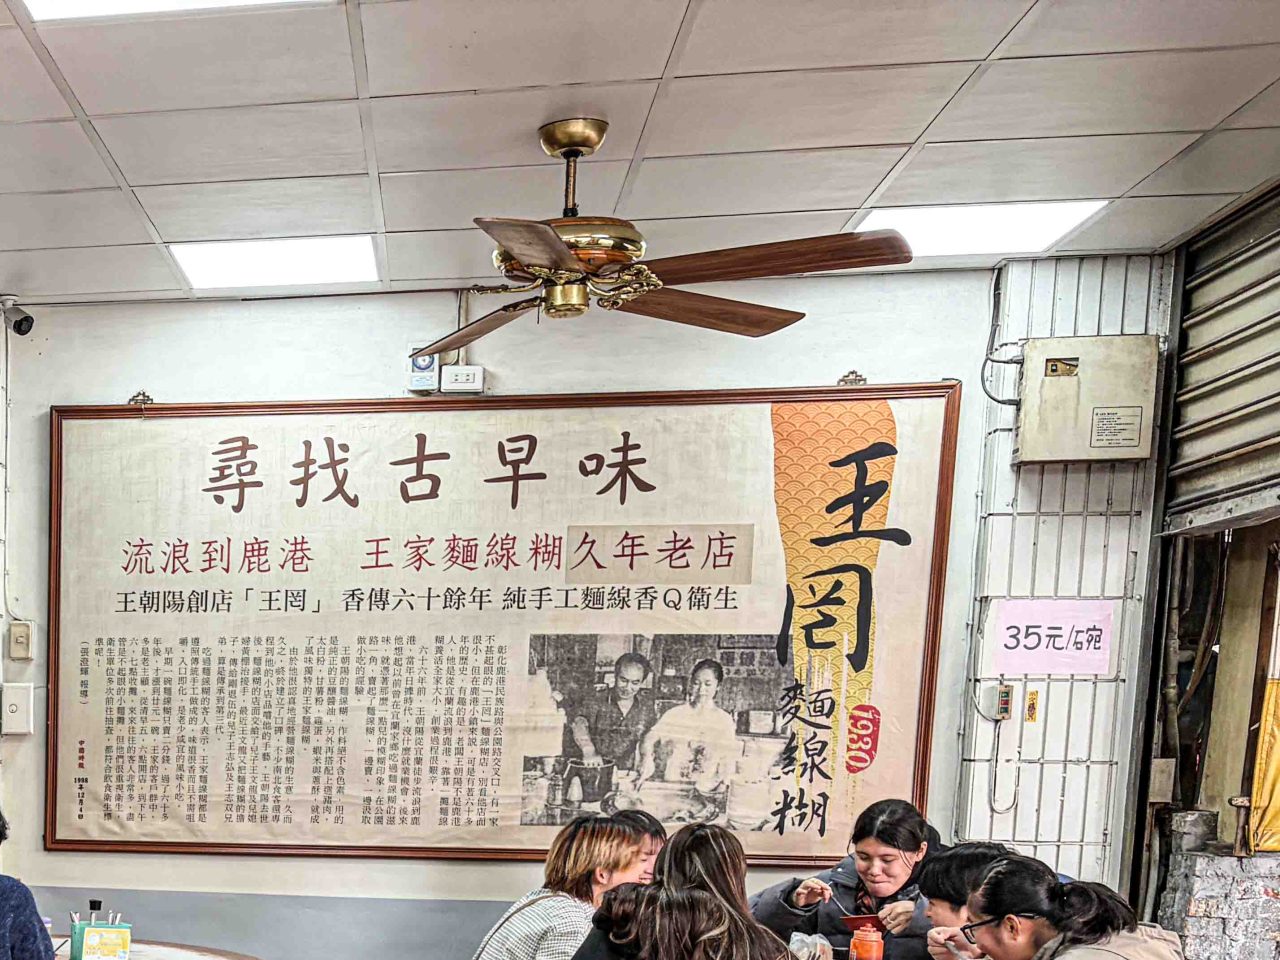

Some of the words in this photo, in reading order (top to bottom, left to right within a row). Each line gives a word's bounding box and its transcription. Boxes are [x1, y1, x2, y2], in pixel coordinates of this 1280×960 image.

[201, 431, 657, 513] 尋找古早味
[121, 535, 315, 576] 流浪到鹿港
[360, 530, 737, 573] 王家麵線糊久年老店
[775, 441, 912, 672] 王罔
[114, 587, 321, 614] 王朝陽創店「王罔」
[341, 586, 493, 613] 香傳六十餘年
[502, 585, 739, 612] 純手工麵線香Q衛生
[1003, 624, 1103, 651] 35元/碗
[770, 678, 836, 838] 麵線糊
[847, 706, 876, 772] 1930
